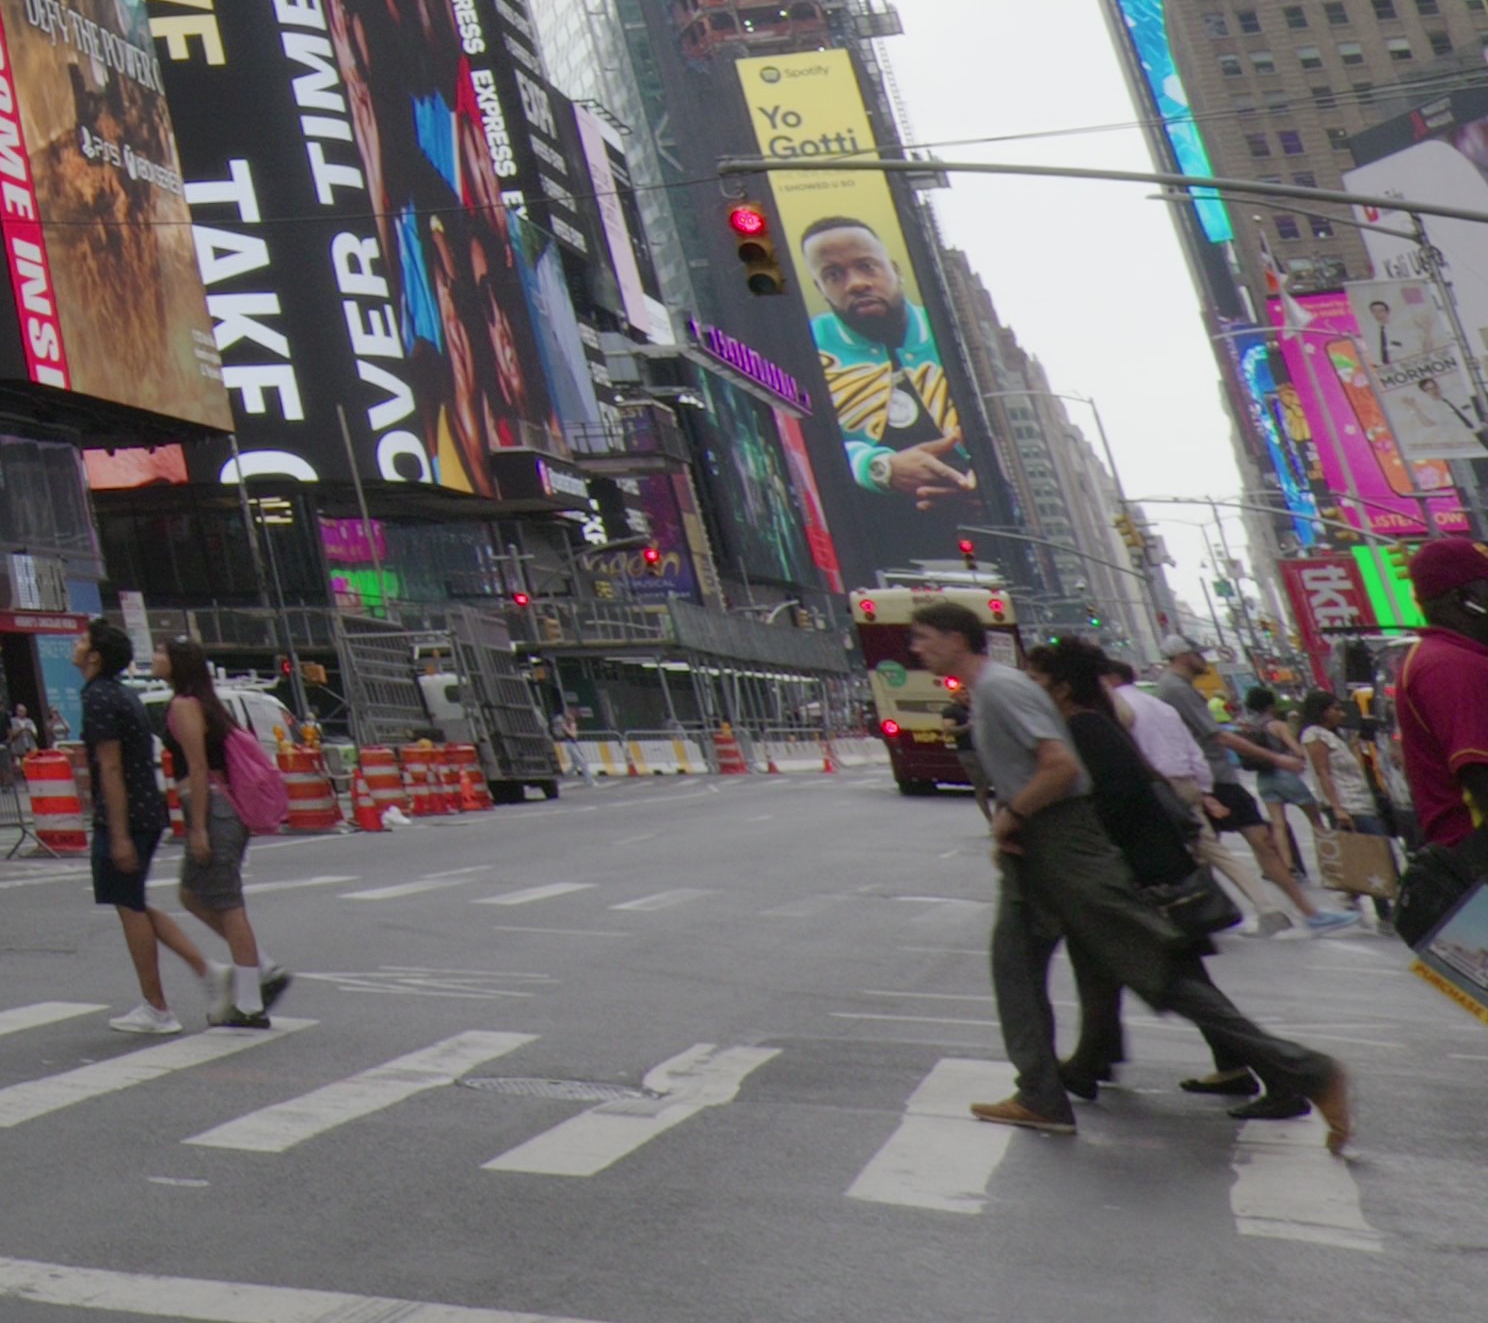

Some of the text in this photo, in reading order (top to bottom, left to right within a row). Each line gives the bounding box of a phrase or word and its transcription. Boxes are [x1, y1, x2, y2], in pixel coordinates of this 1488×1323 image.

[783, 64, 830, 79] Spotify
[469, 68, 518, 178] EXPRESS
[757, 104, 803, 130] Yo
[768, 127, 859, 159] Gotti
[183, 158, 307, 422] TAKE
[333, 230, 435, 486] OVER
[1379, 356, 1458, 389] MORMON
[1434, 511, 1465, 526] OW
[1300, 563, 1361, 631] tkt
